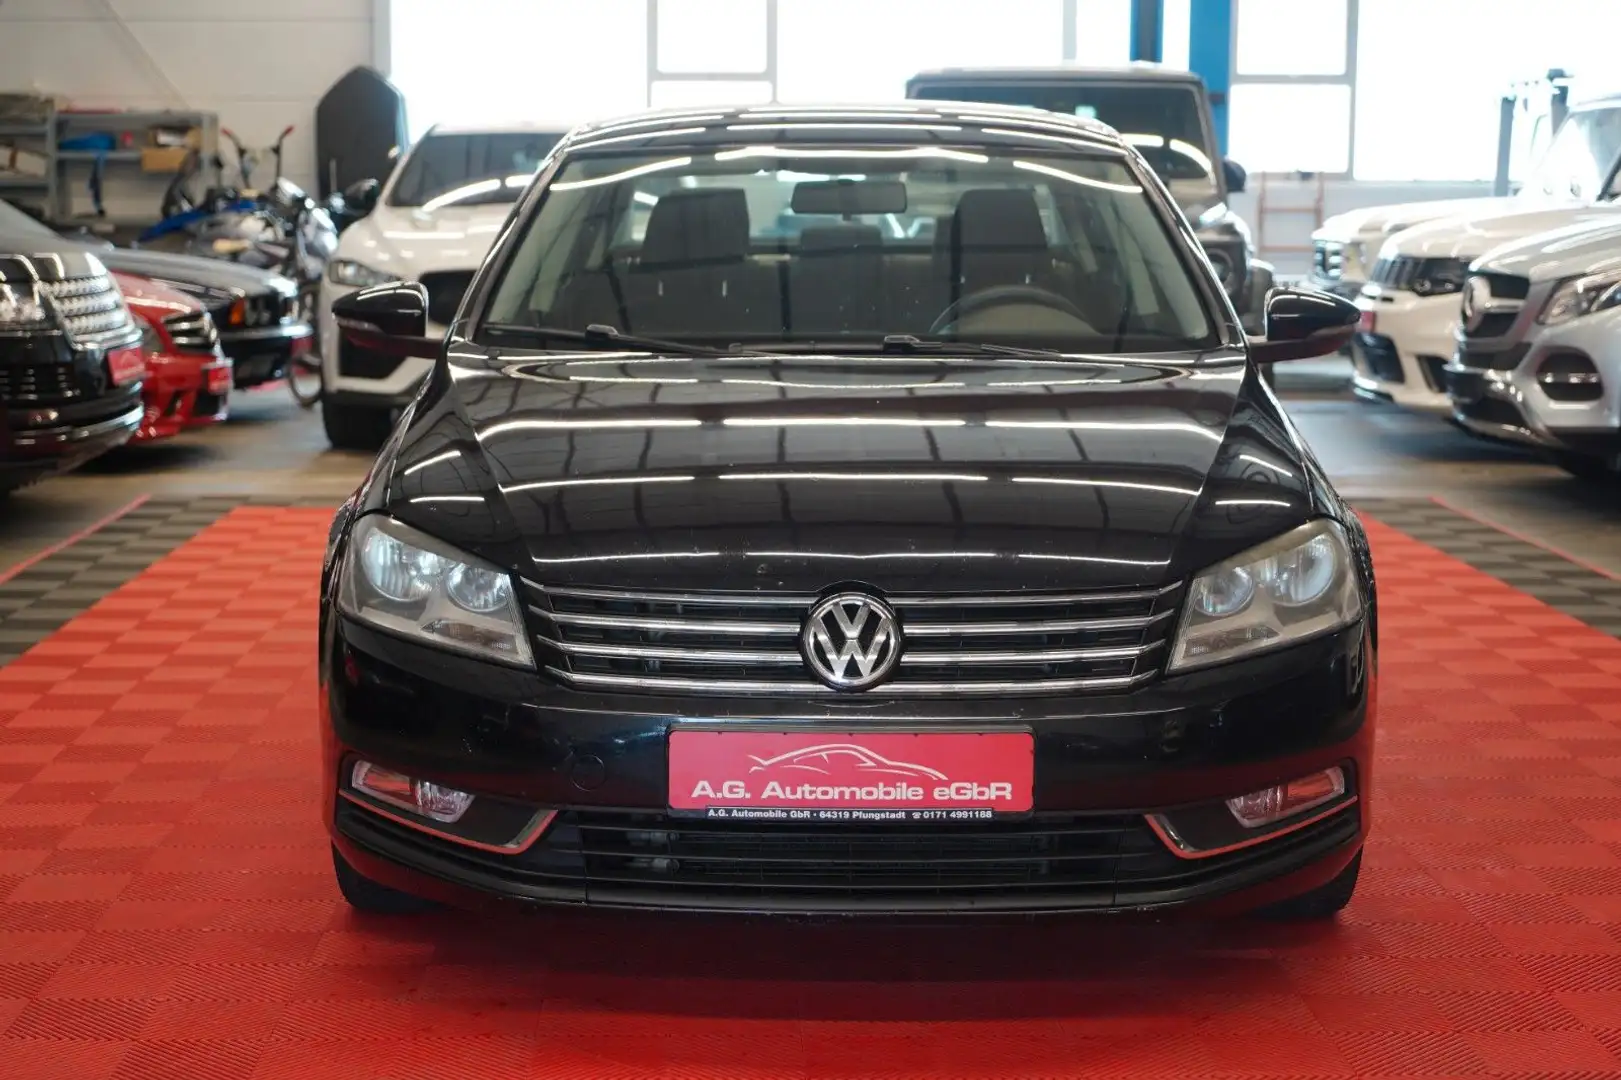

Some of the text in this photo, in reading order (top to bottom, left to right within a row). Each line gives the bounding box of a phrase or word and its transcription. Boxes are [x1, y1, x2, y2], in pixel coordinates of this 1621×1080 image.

[807, 597, 896, 684] VW
[691, 780, 1013, 802] A.G. Automobile eGbR
[708, 809, 729, 817] A.G.
[732, 809, 788, 818] Automobile
[790, 810, 811, 818] GbR
[819, 810, 849, 819] 64319
[853, 810, 906, 820] Pfungstadt
[923, 810, 947, 819] 0171
